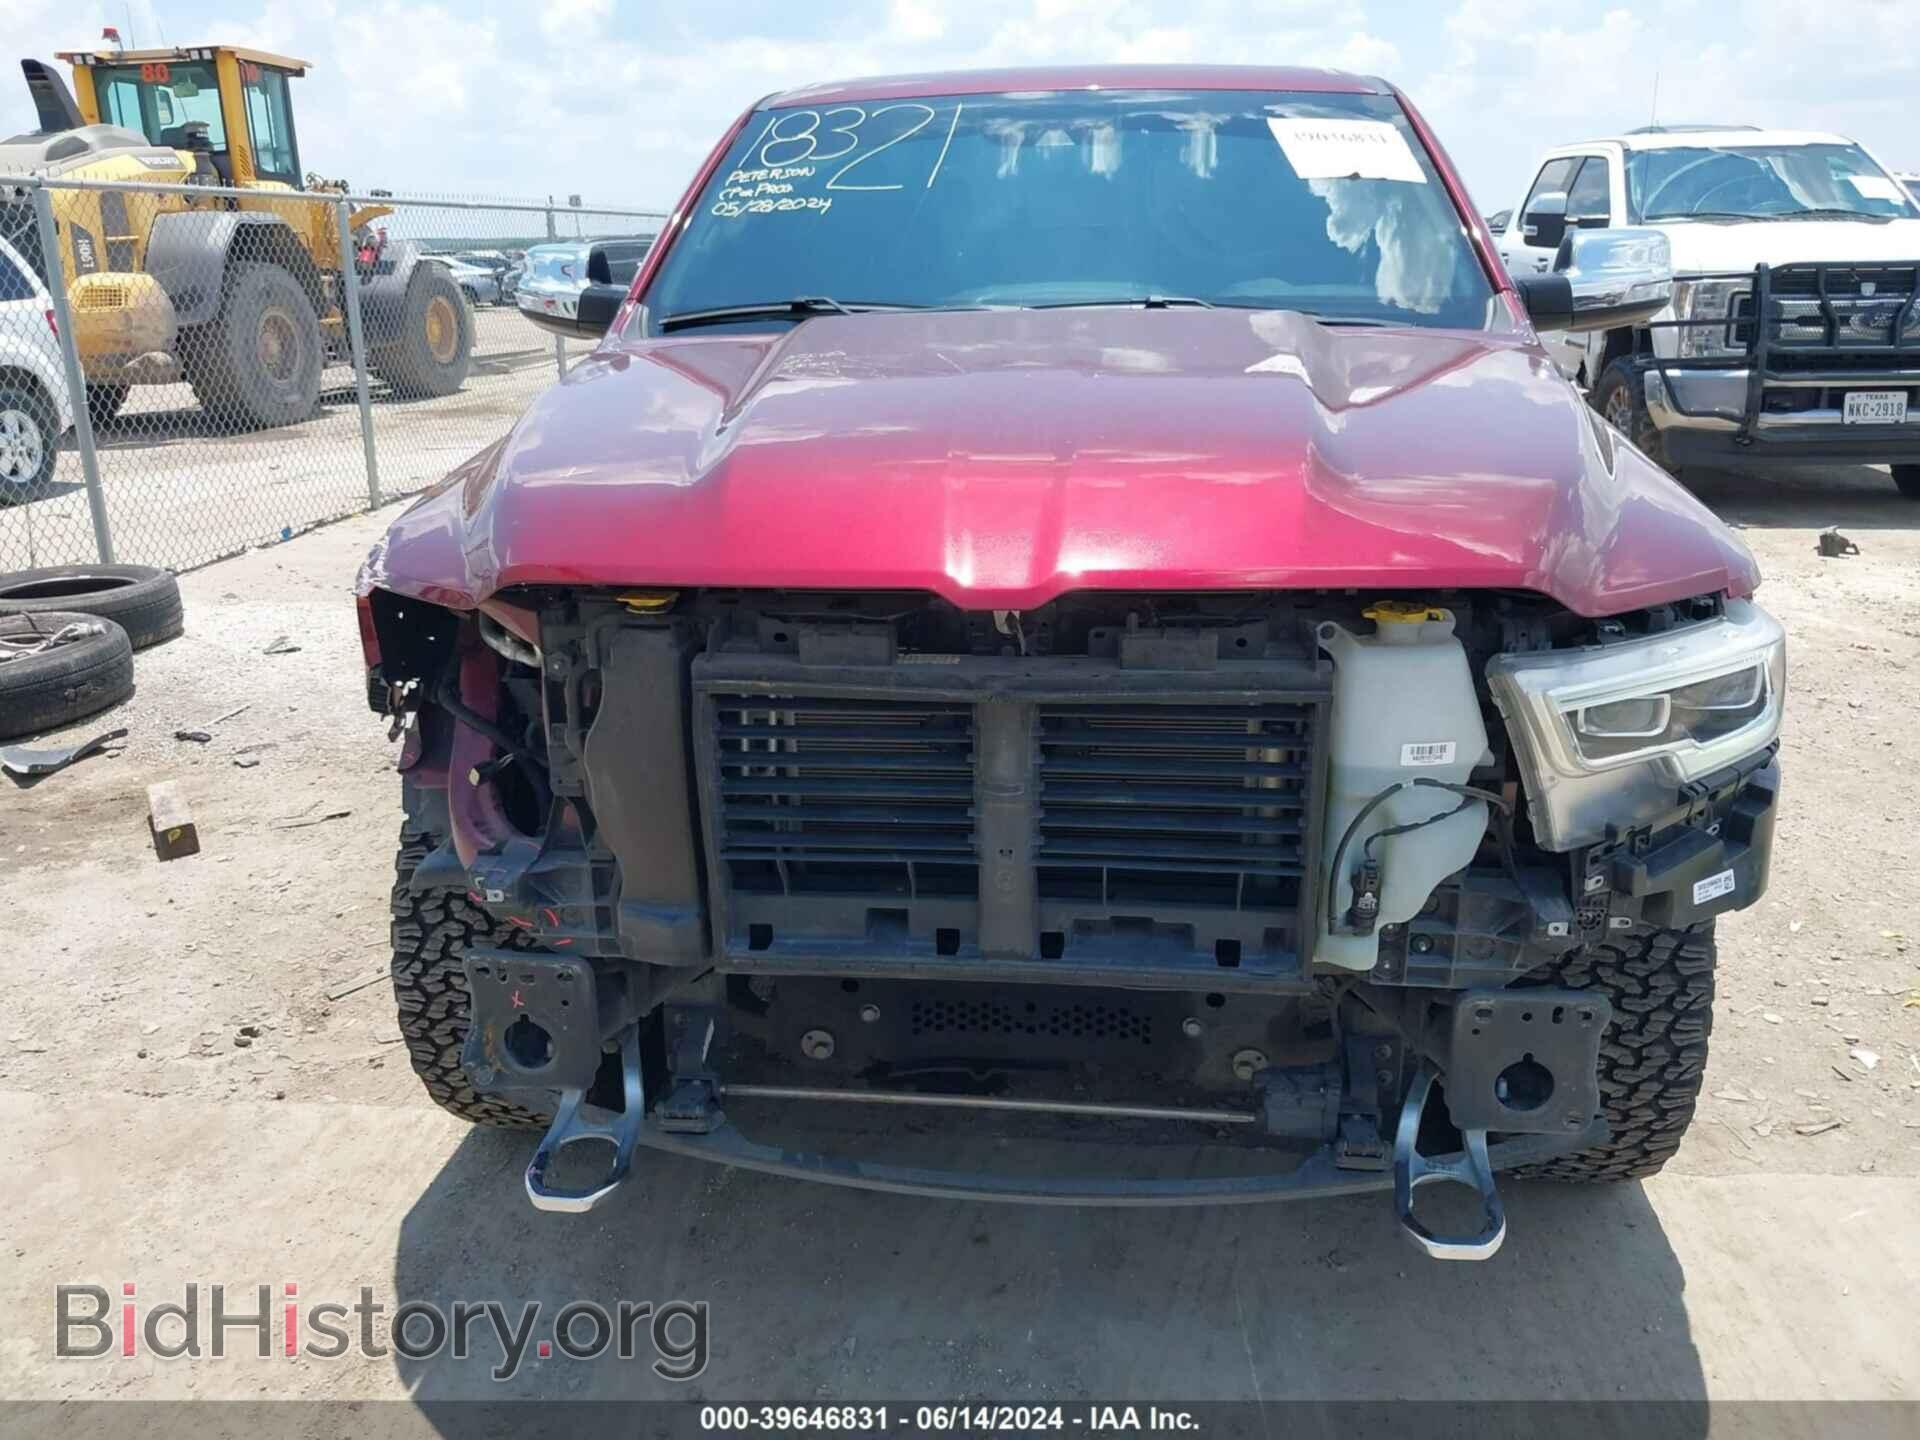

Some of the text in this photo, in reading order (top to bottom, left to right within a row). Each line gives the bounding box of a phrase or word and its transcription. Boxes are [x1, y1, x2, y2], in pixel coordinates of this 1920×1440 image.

[142, 63, 169, 82] 80
[738, 102, 962, 190] 18321
[725, 166, 816, 187] PETERSON
[711, 197, 833, 217] 05/28/2024
